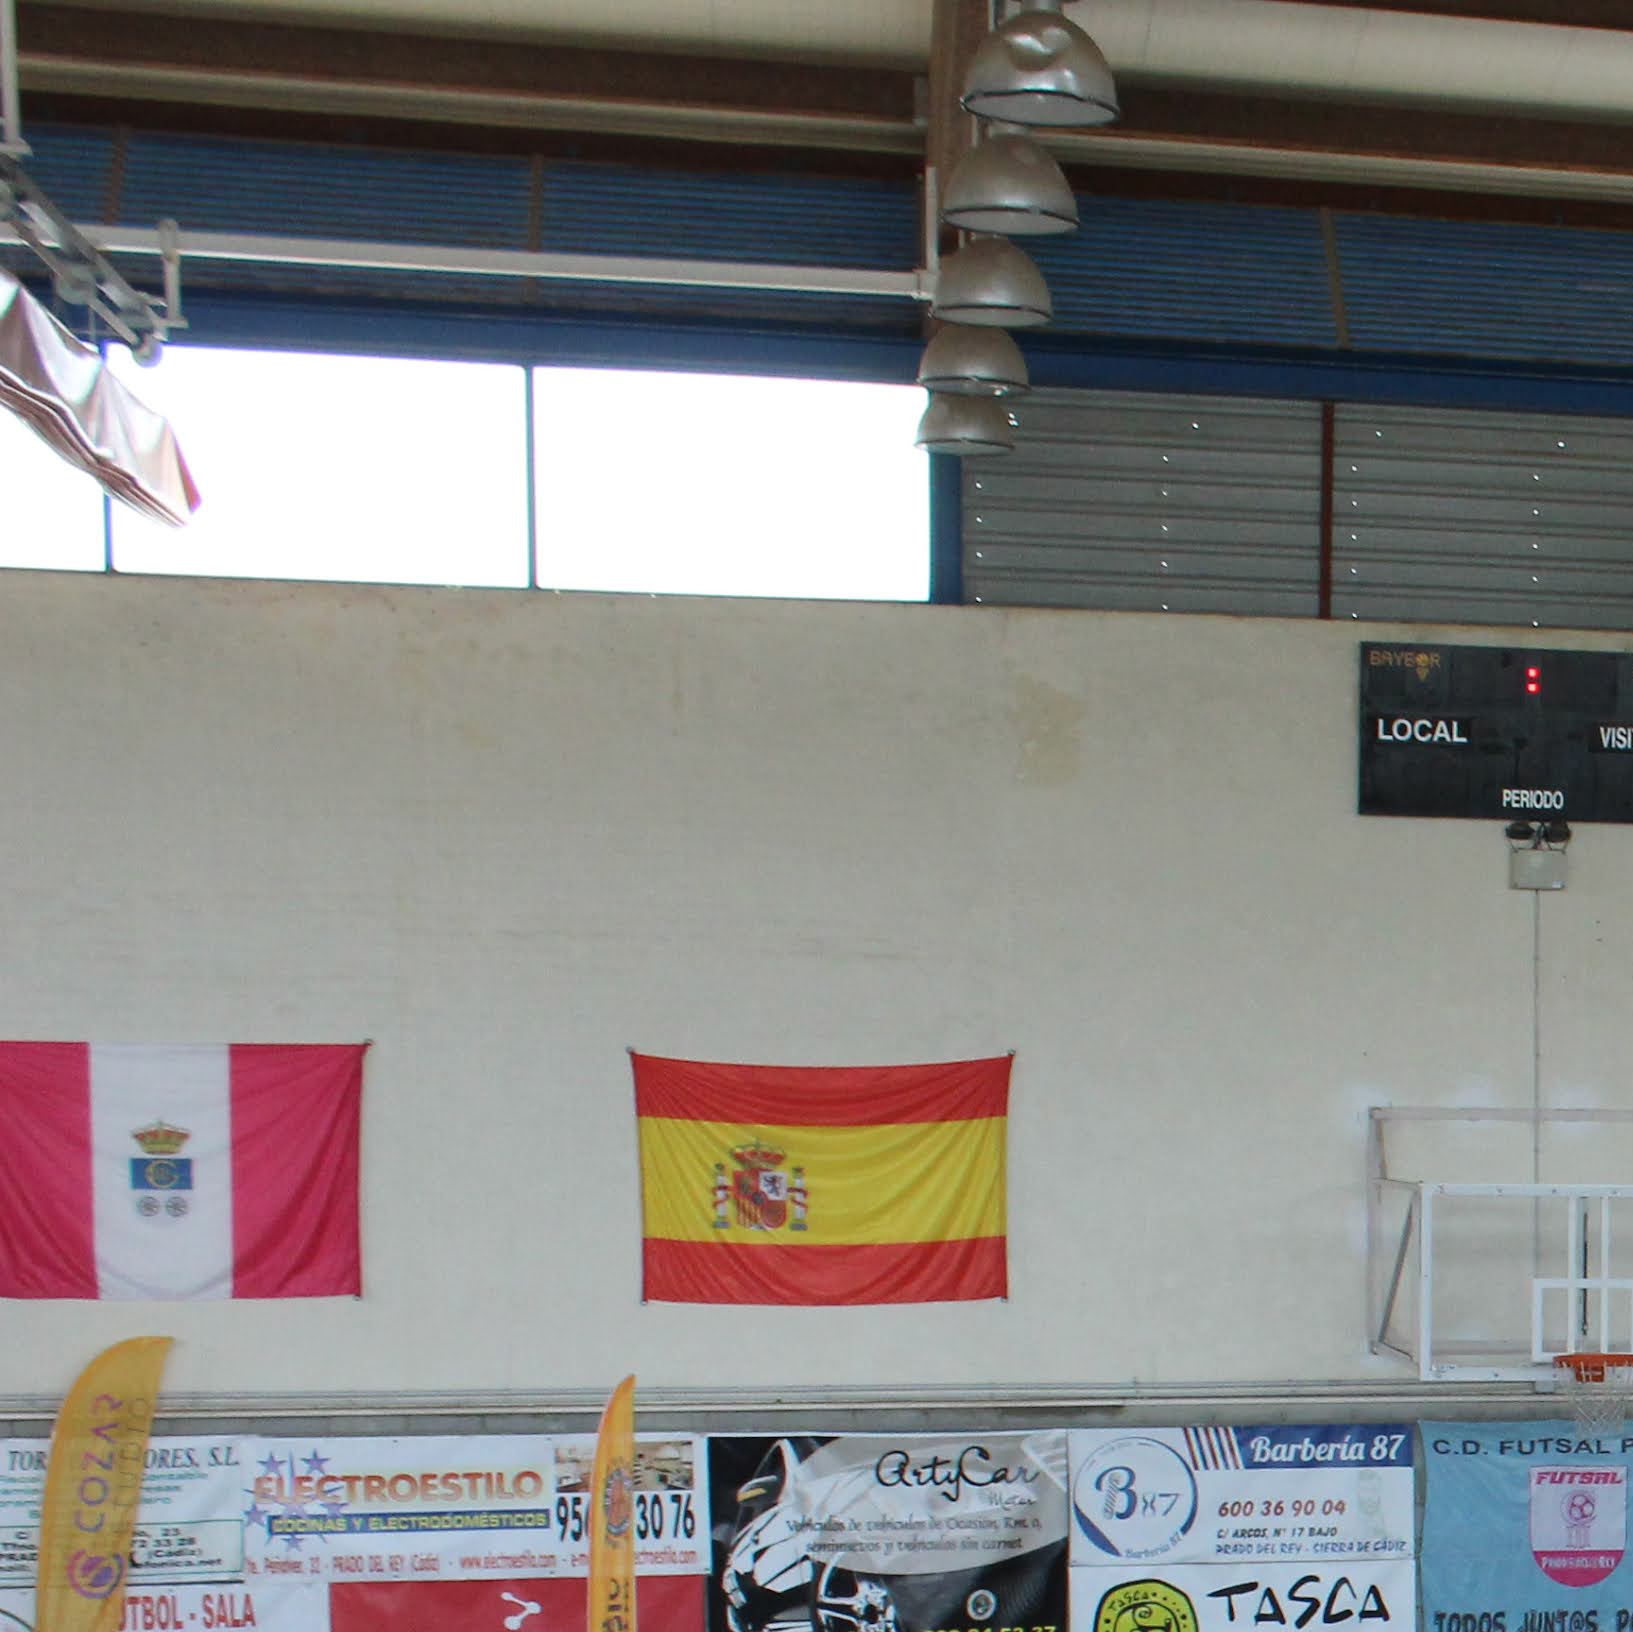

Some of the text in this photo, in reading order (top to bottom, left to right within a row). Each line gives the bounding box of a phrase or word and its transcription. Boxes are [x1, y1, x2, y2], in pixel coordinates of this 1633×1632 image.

[1378, 719, 1467, 743] LOCAL
[1503, 789, 1563, 809] PERIODO
[1251, 1435, 1405, 1463] Barbería 87
[1432, 1439, 1489, 1455] C.D.
[1499, 1437, 1611, 1455] FUTSAL
[255, 1471, 543, 1503] ELECTROESTILO
[876, 1446, 1040, 1501] ArtyCar
[637, 1493, 695, 1539] 30 76
[202, 1594, 256, 1628] SALA
[1207, 1575, 1391, 1629] TASCA
